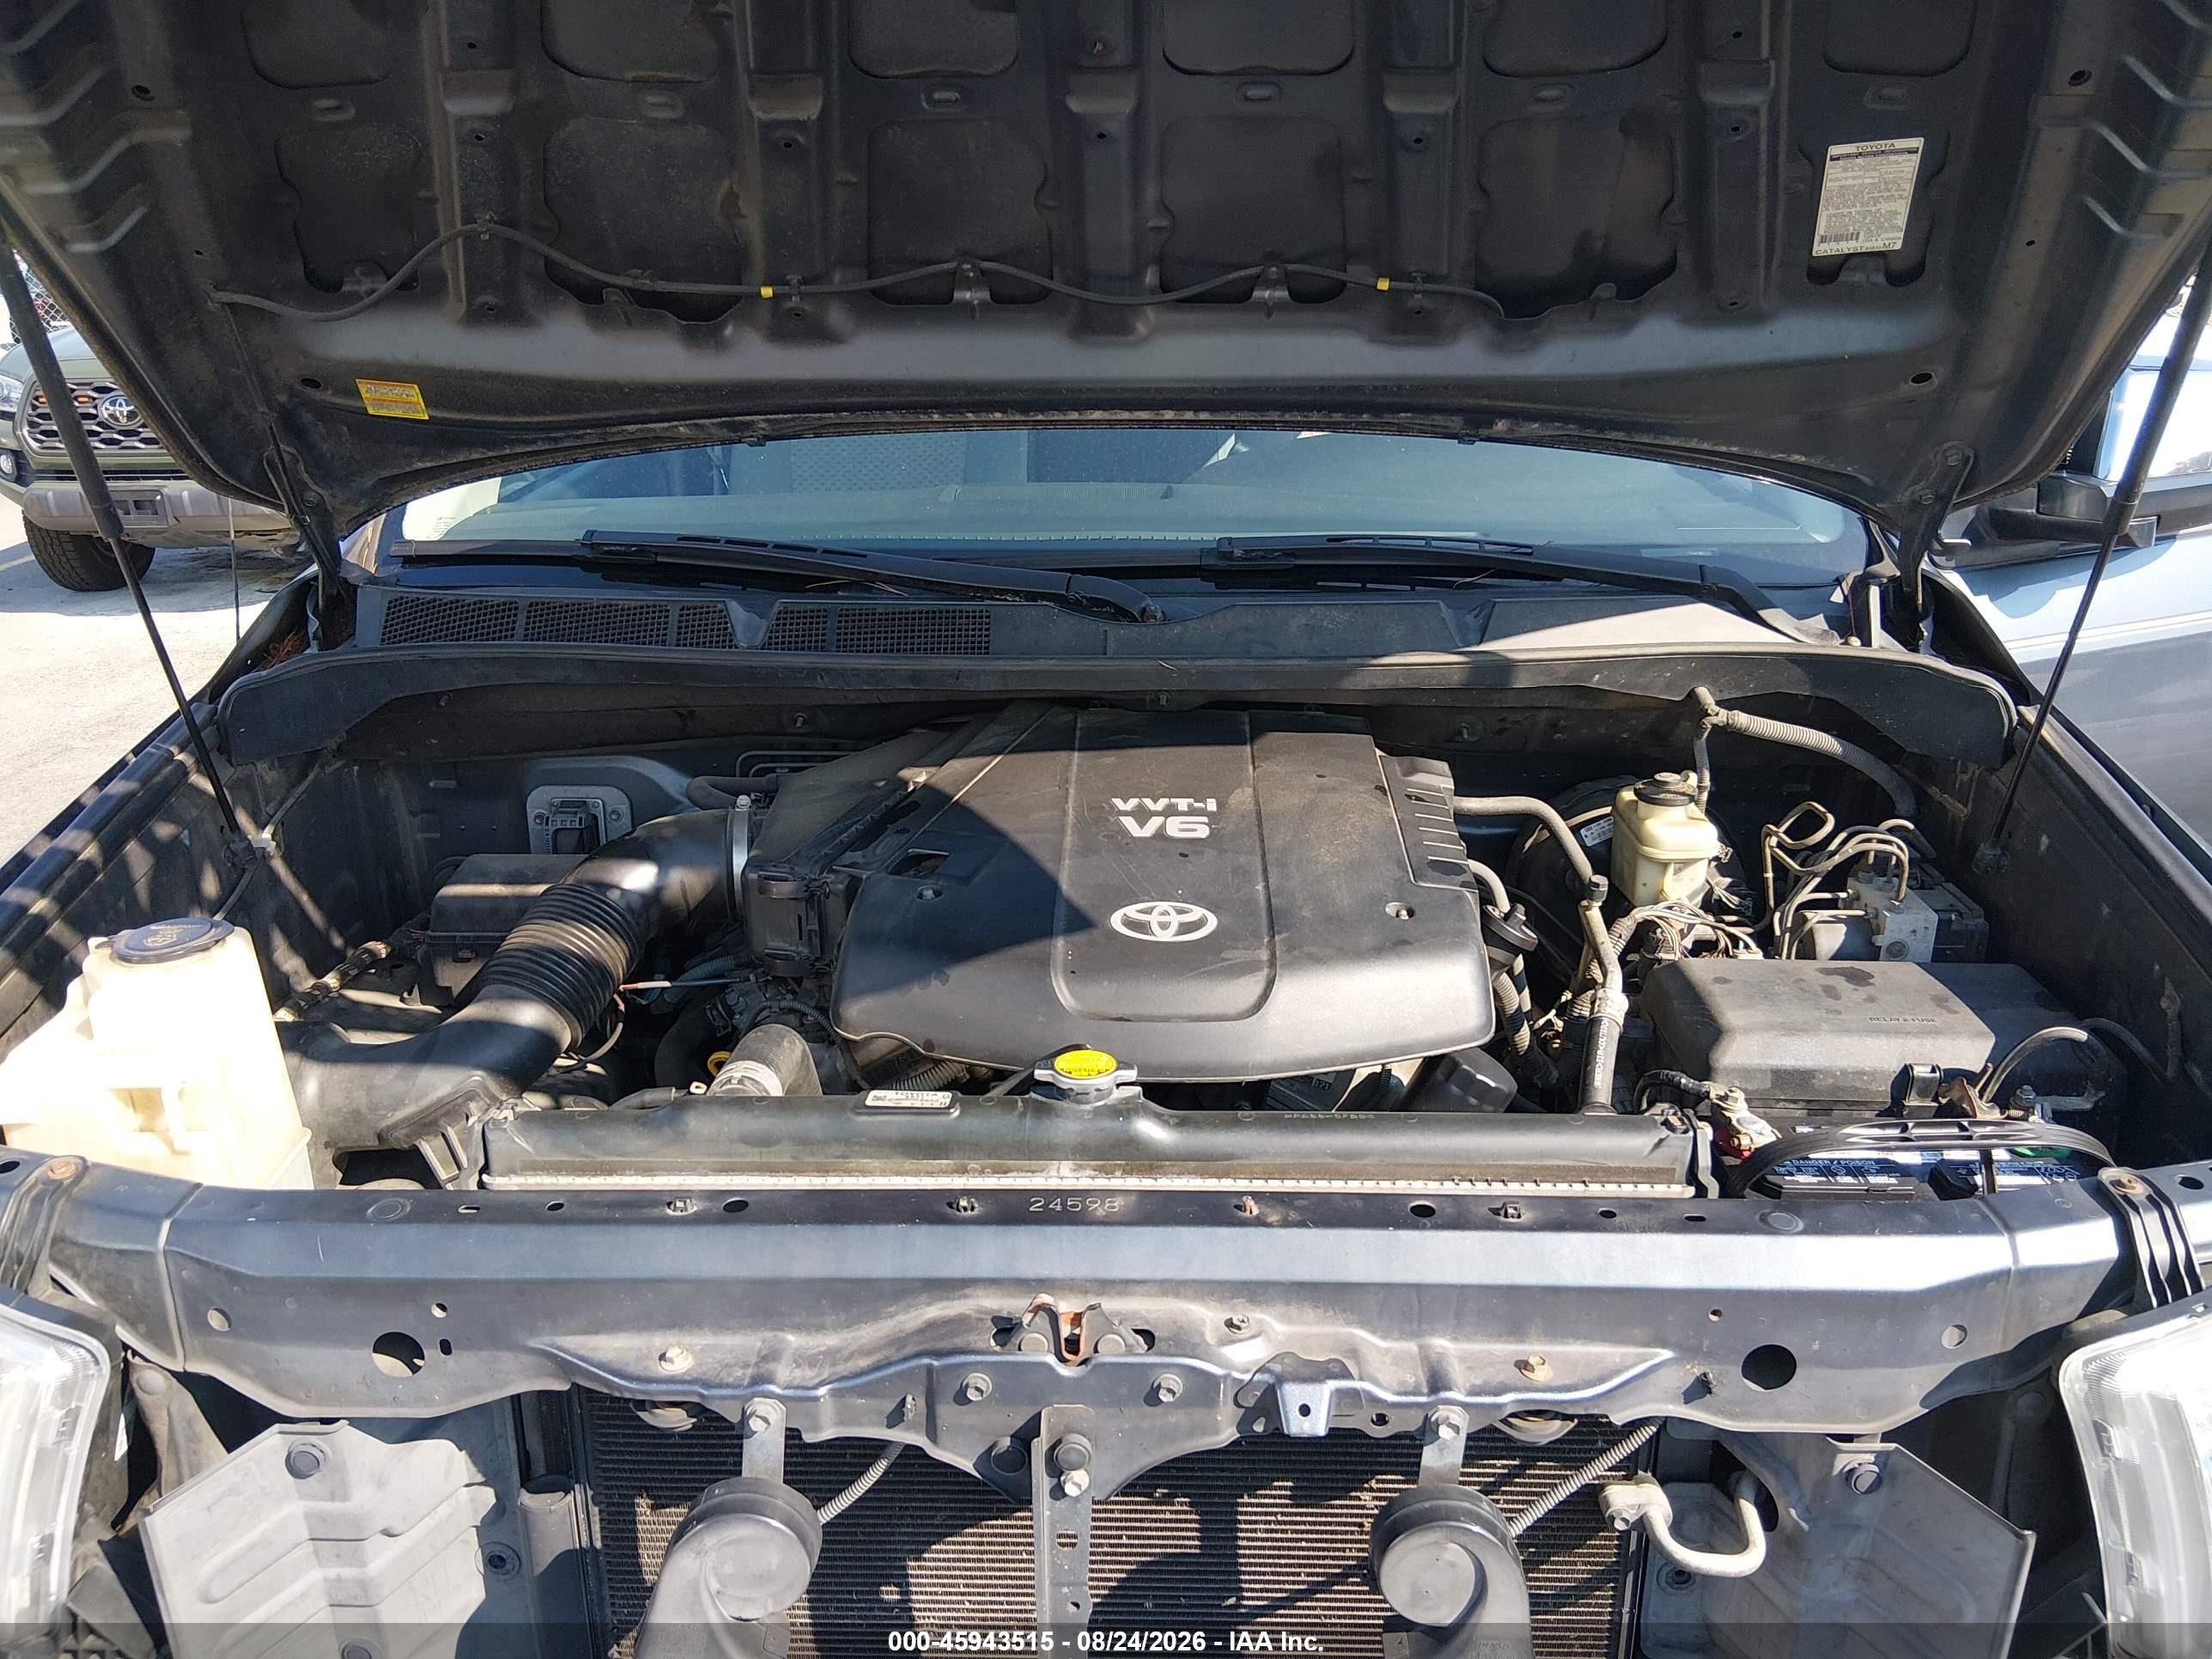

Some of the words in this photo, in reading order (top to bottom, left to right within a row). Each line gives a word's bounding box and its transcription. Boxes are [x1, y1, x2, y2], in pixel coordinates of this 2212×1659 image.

[1855, 143, 1896, 151] TOYOTA
[1815, 246, 1864, 255] CATALYST
[1117, 815, 1211, 839] V6
[1028, 1197, 1121, 1212] 24598
